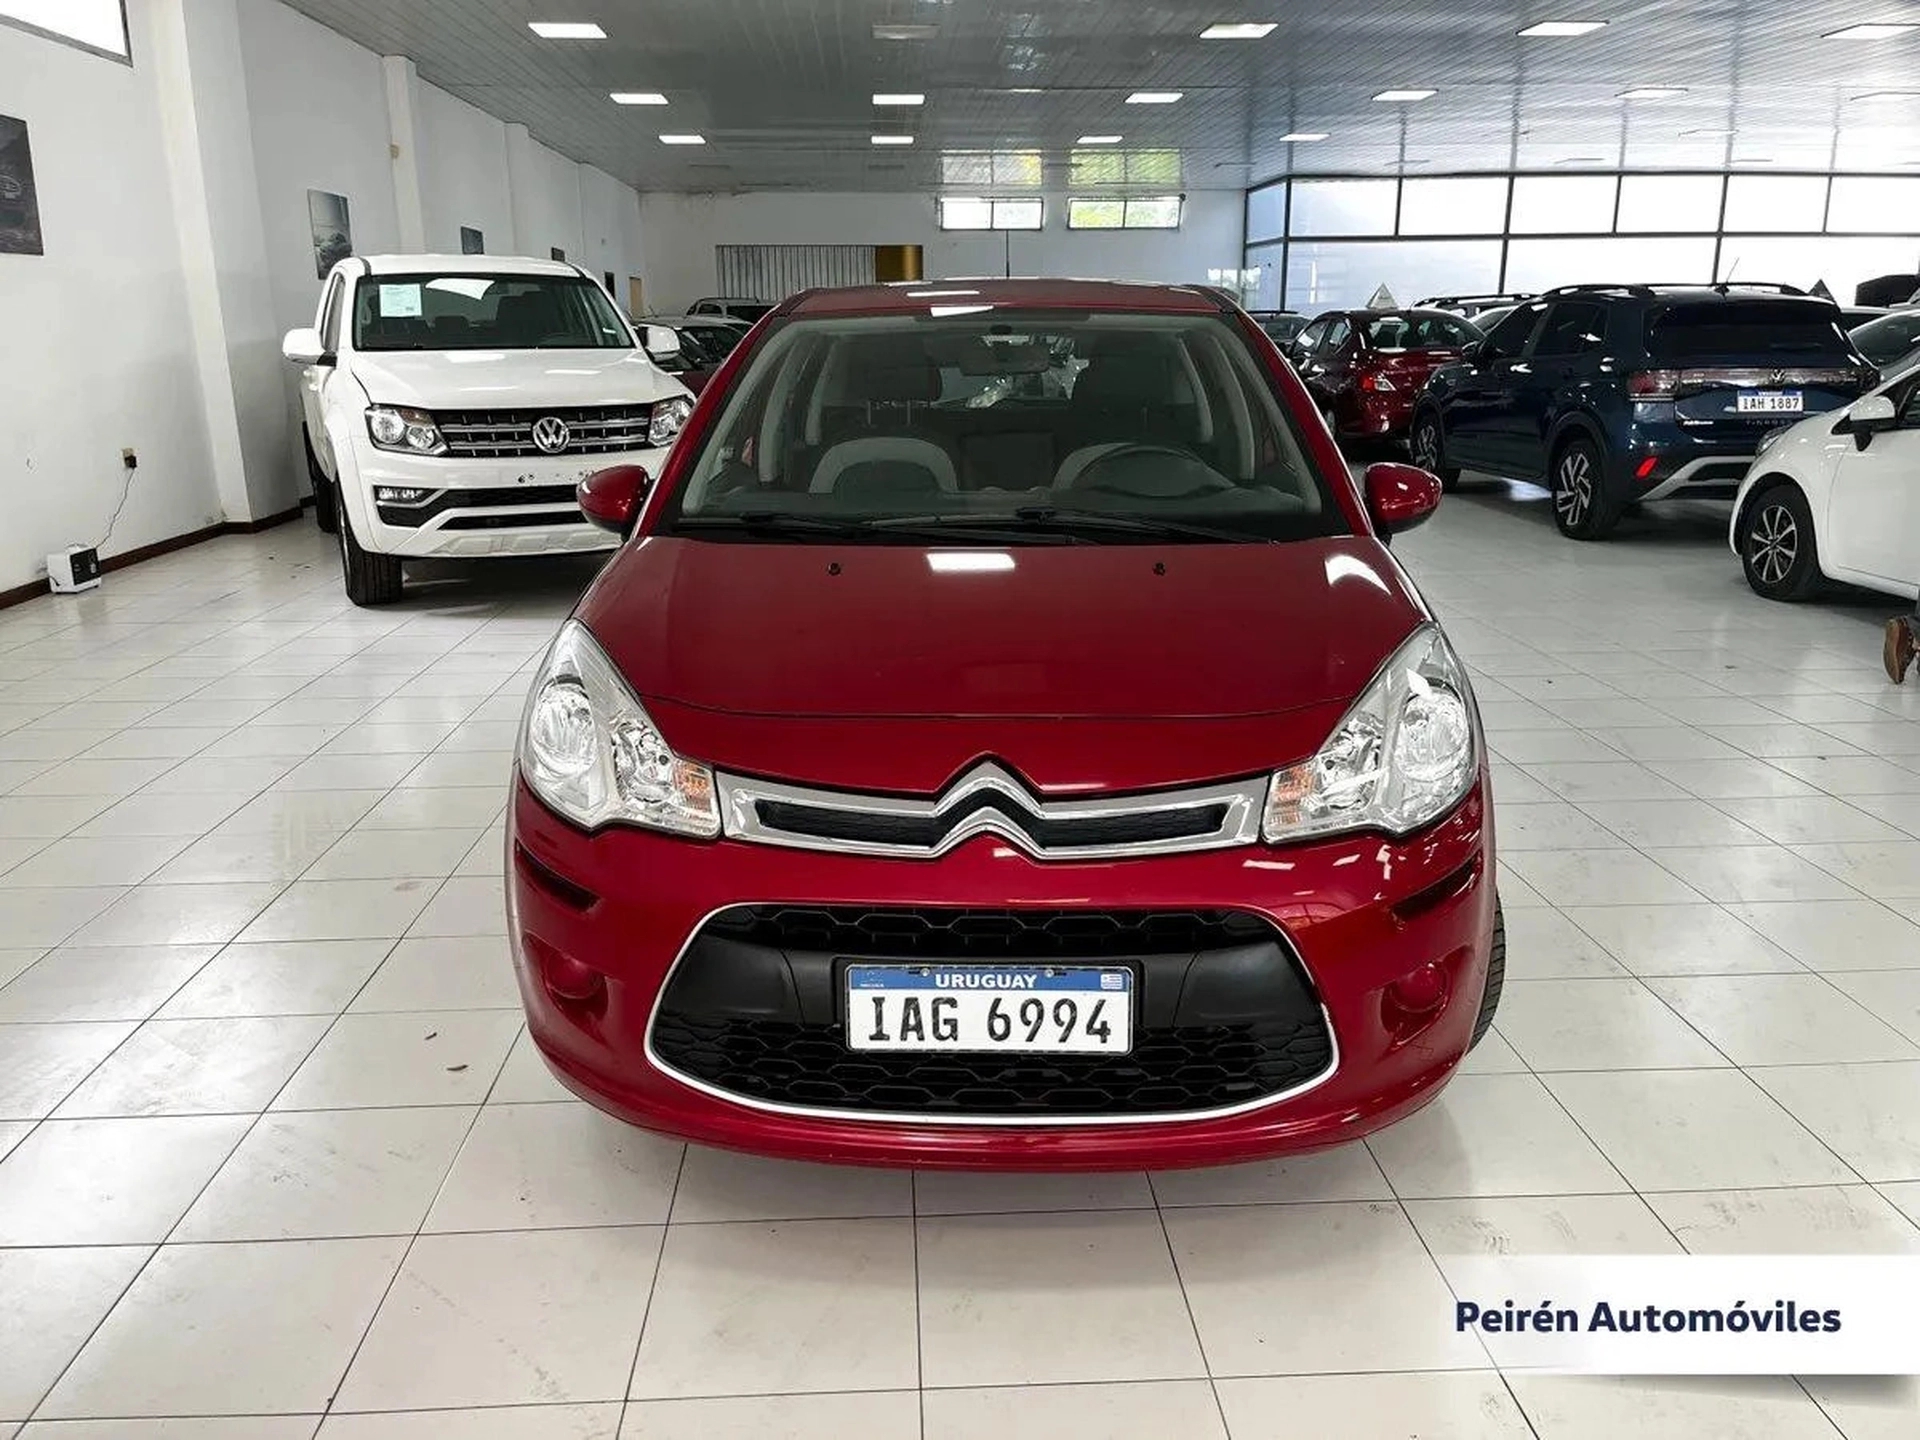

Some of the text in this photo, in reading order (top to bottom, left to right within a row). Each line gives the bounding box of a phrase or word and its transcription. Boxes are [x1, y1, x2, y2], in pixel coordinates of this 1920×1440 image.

[1743, 398, 1765, 410] IAH
[934, 973, 1037, 989] URUGUAY
[868, 996, 1112, 1044] IAG 6994
